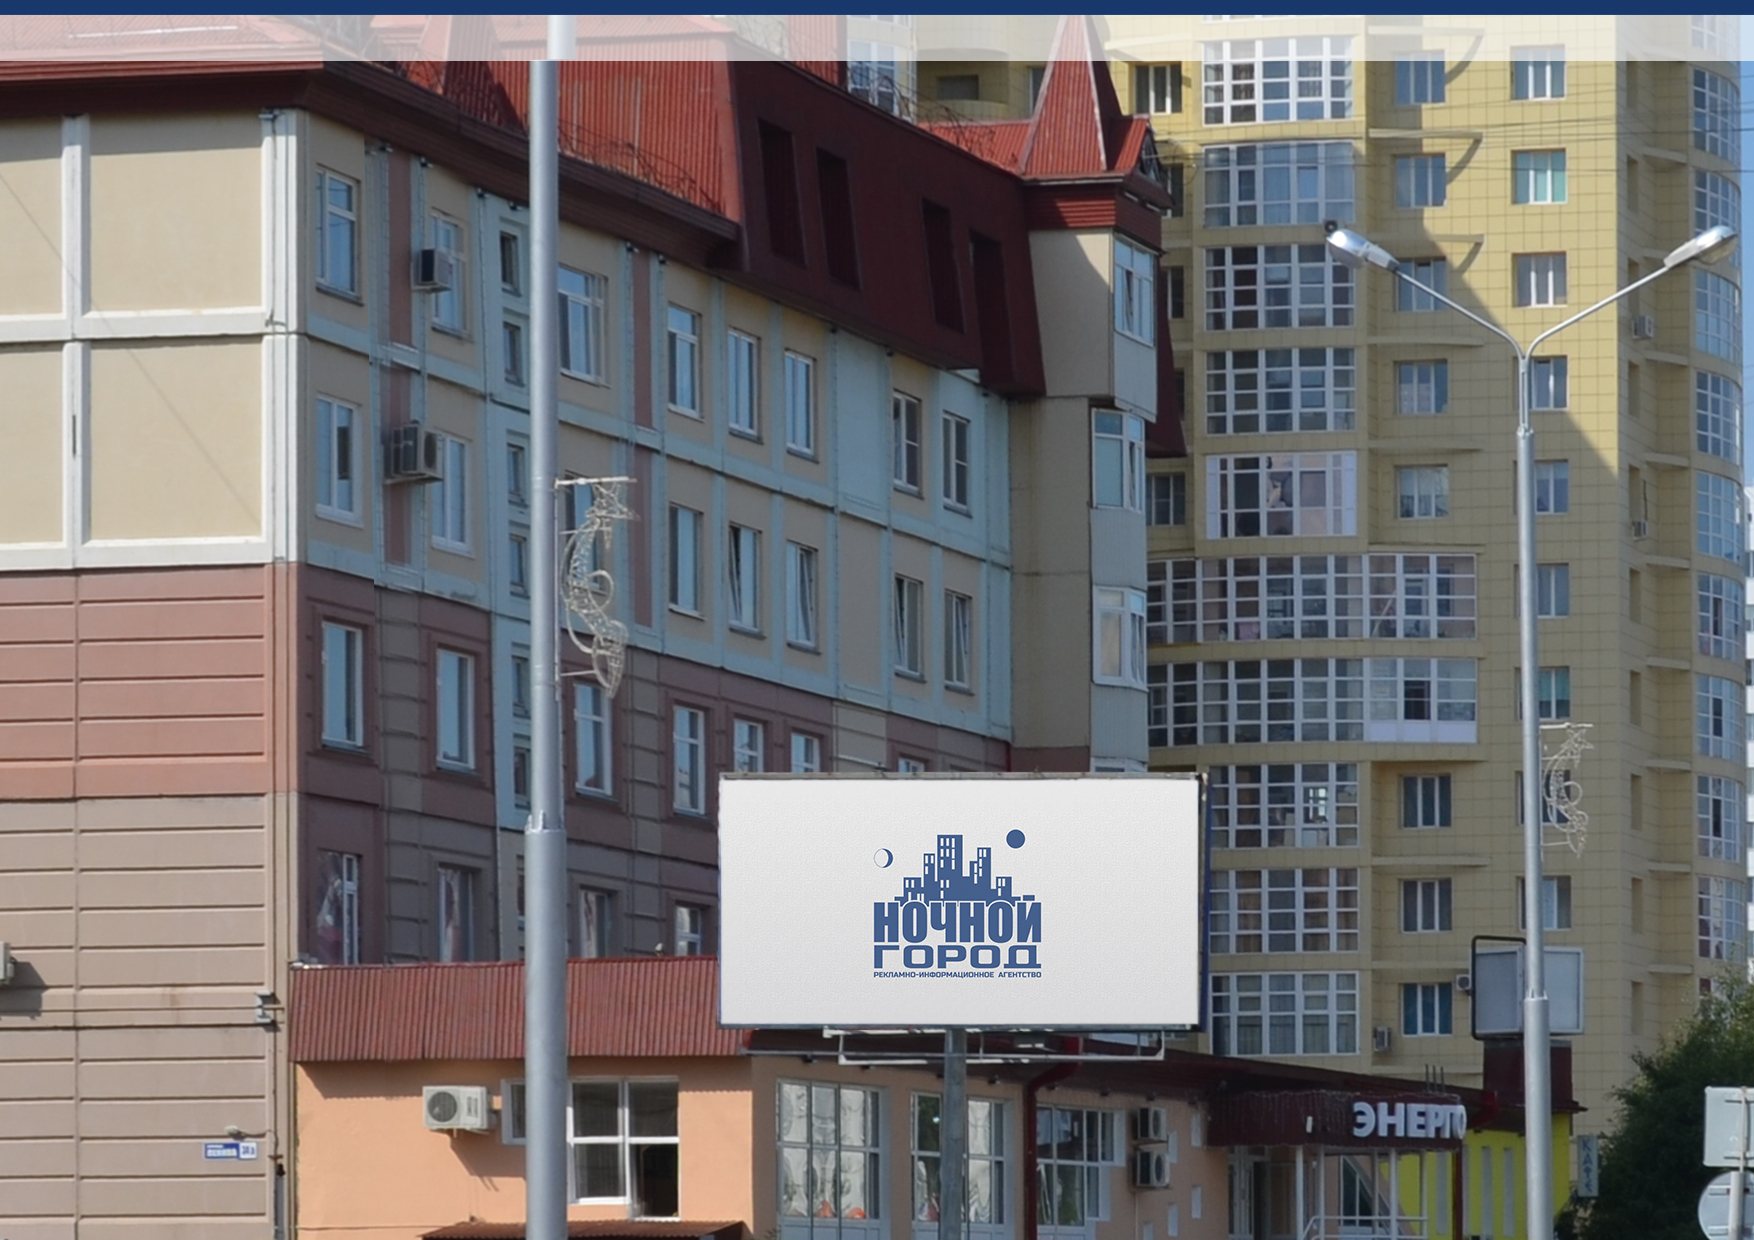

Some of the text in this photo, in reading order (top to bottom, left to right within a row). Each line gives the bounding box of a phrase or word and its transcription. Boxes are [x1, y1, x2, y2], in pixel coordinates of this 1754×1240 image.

[873, 895, 1042, 943] НОЧНОЙ
[873, 944, 1042, 969] ГОРОД
[873, 971, 1042, 979] РЕКЛАМНО-ИНФОРМАЦИОННОЕ АГЕНТСТВО
